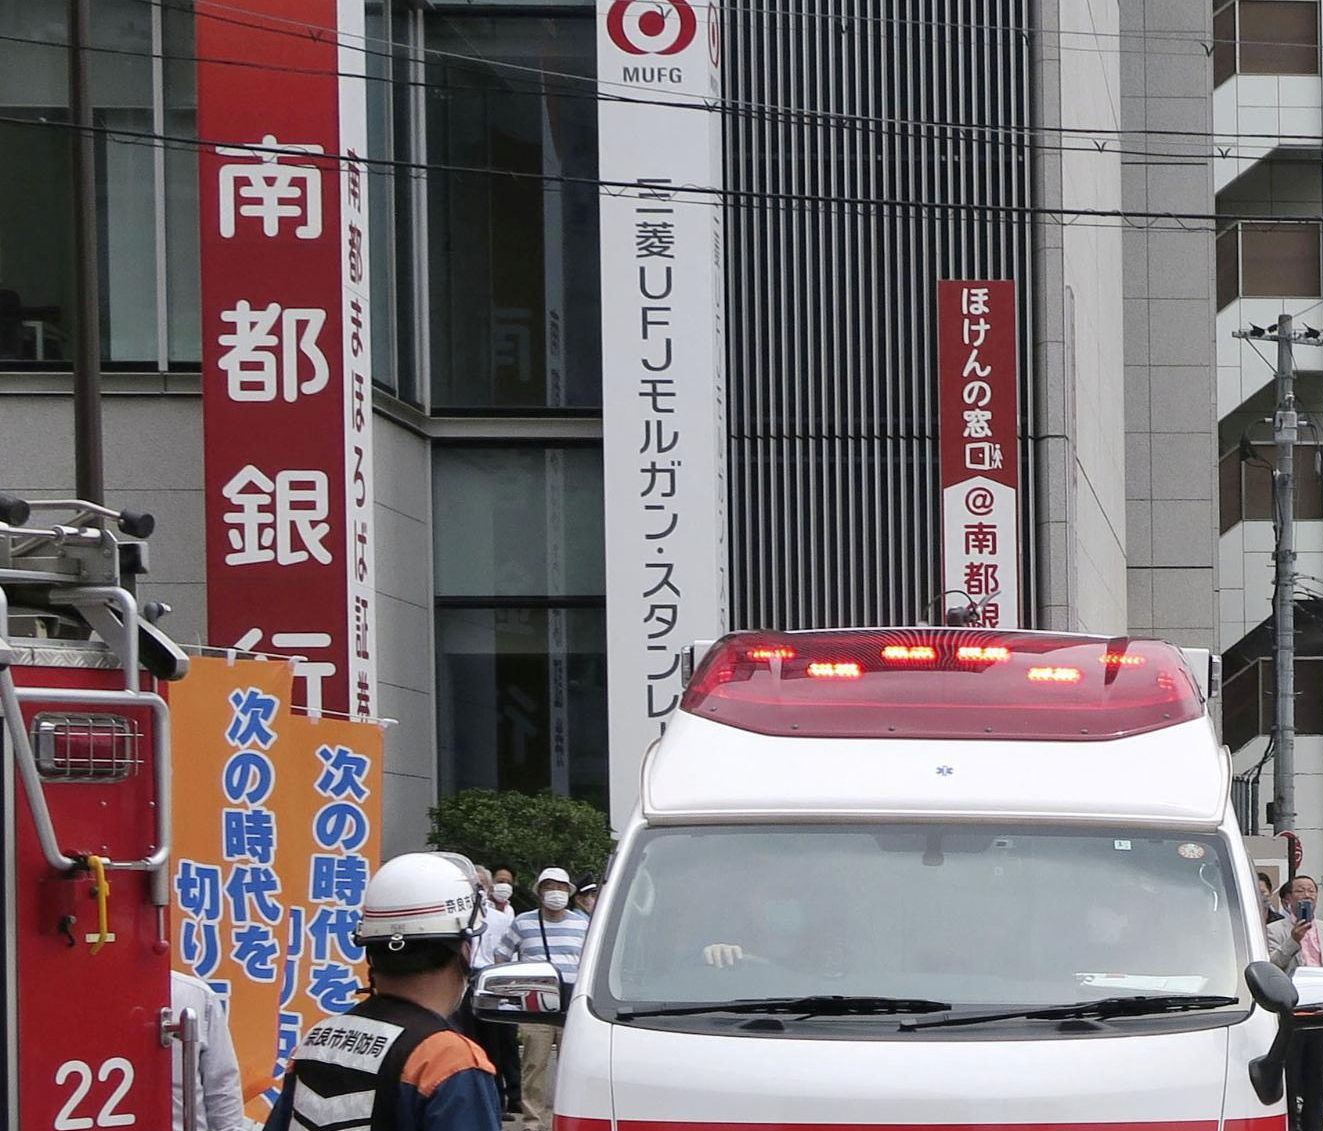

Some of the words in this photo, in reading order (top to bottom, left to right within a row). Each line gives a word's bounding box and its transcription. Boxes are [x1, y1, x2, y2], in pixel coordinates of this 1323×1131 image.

[623, 66, 683, 84] MUFG
[214, 134, 333, 713] 南都銀行
[961, 287, 993, 470] ほけんの窓口
[222, 687, 281, 982] 次の時代を
[306, 744, 371, 1015] 次の時代を
[175, 858, 228, 995] 切り
[445, 896, 475, 913] 奈良市
[54, 1058, 136, 1131] 22
[304, 1026, 389, 1058] 奈良市消防局
